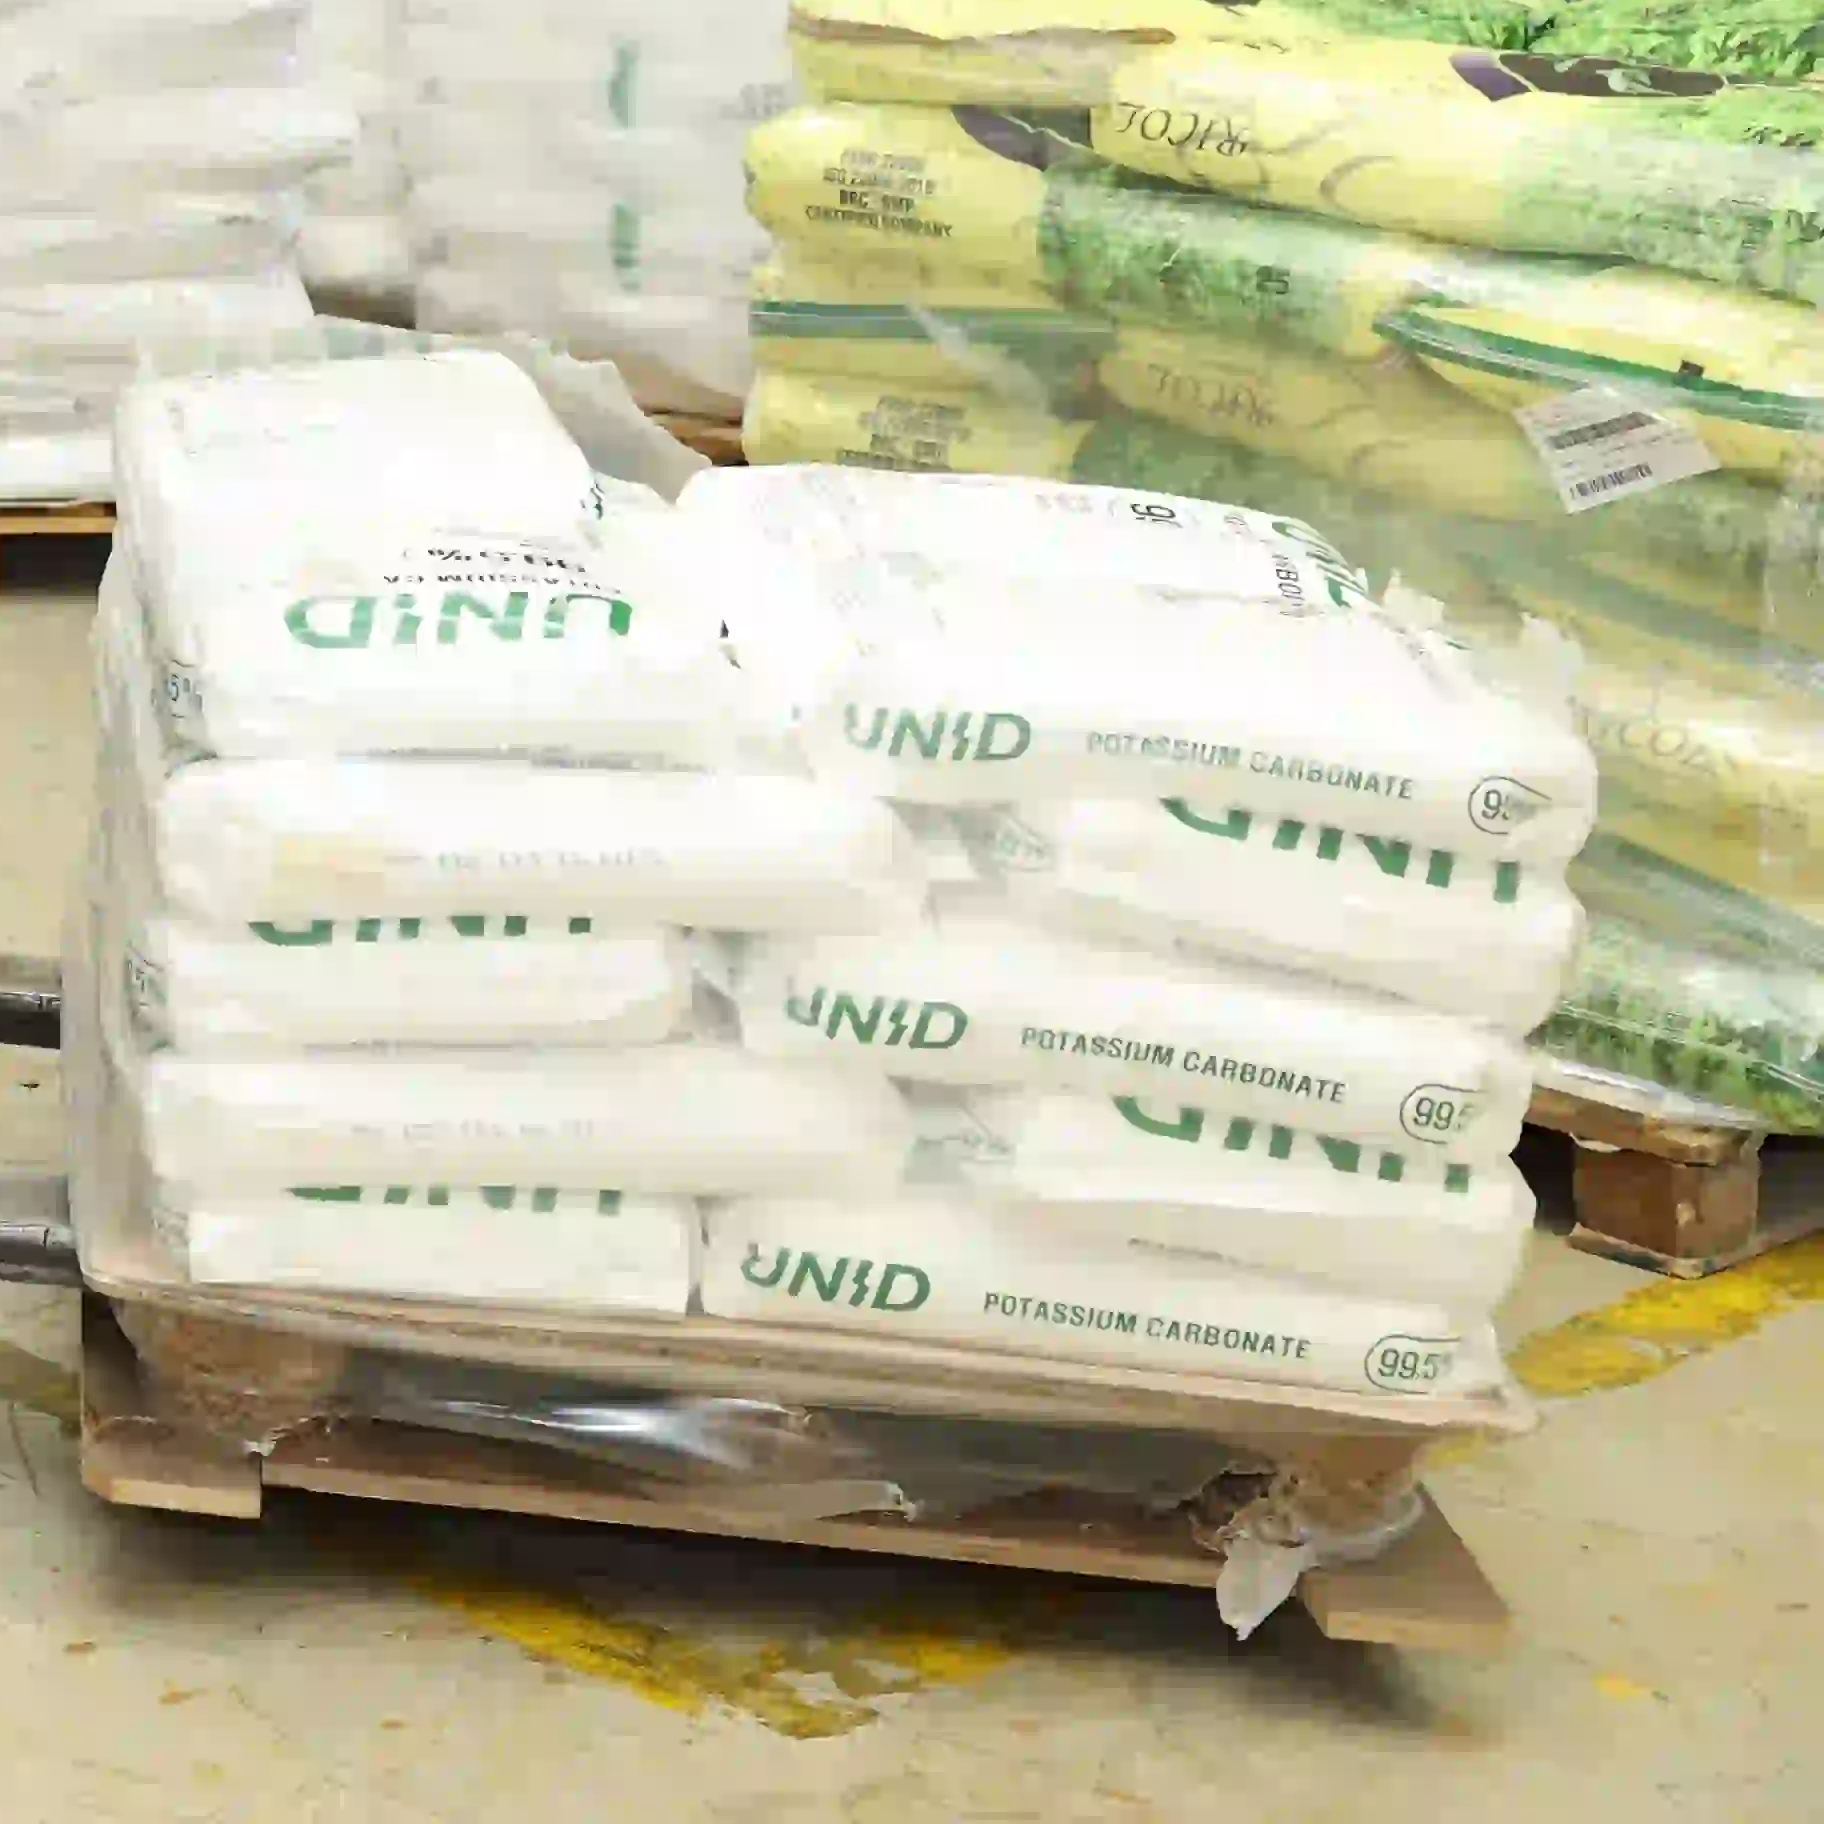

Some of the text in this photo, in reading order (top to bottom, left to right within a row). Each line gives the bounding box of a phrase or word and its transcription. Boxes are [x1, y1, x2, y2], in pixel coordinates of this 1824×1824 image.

[282, 589, 634, 649] UNID
[843, 700, 1032, 762] UNID
[1086, 730, 1242, 768] POTASSIUM
[1249, 750, 1415, 801] CARBONATE
[783, 984, 969, 1050] UNID
[1020, 1025, 1176, 1068] POTASSIUM
[1182, 1049, 1348, 1105] CARBONATE
[739, 1239, 932, 1313] UNID
[983, 1290, 1138, 1336] POTASSIUM
[1145, 1316, 1314, 1360] CARBONATE
